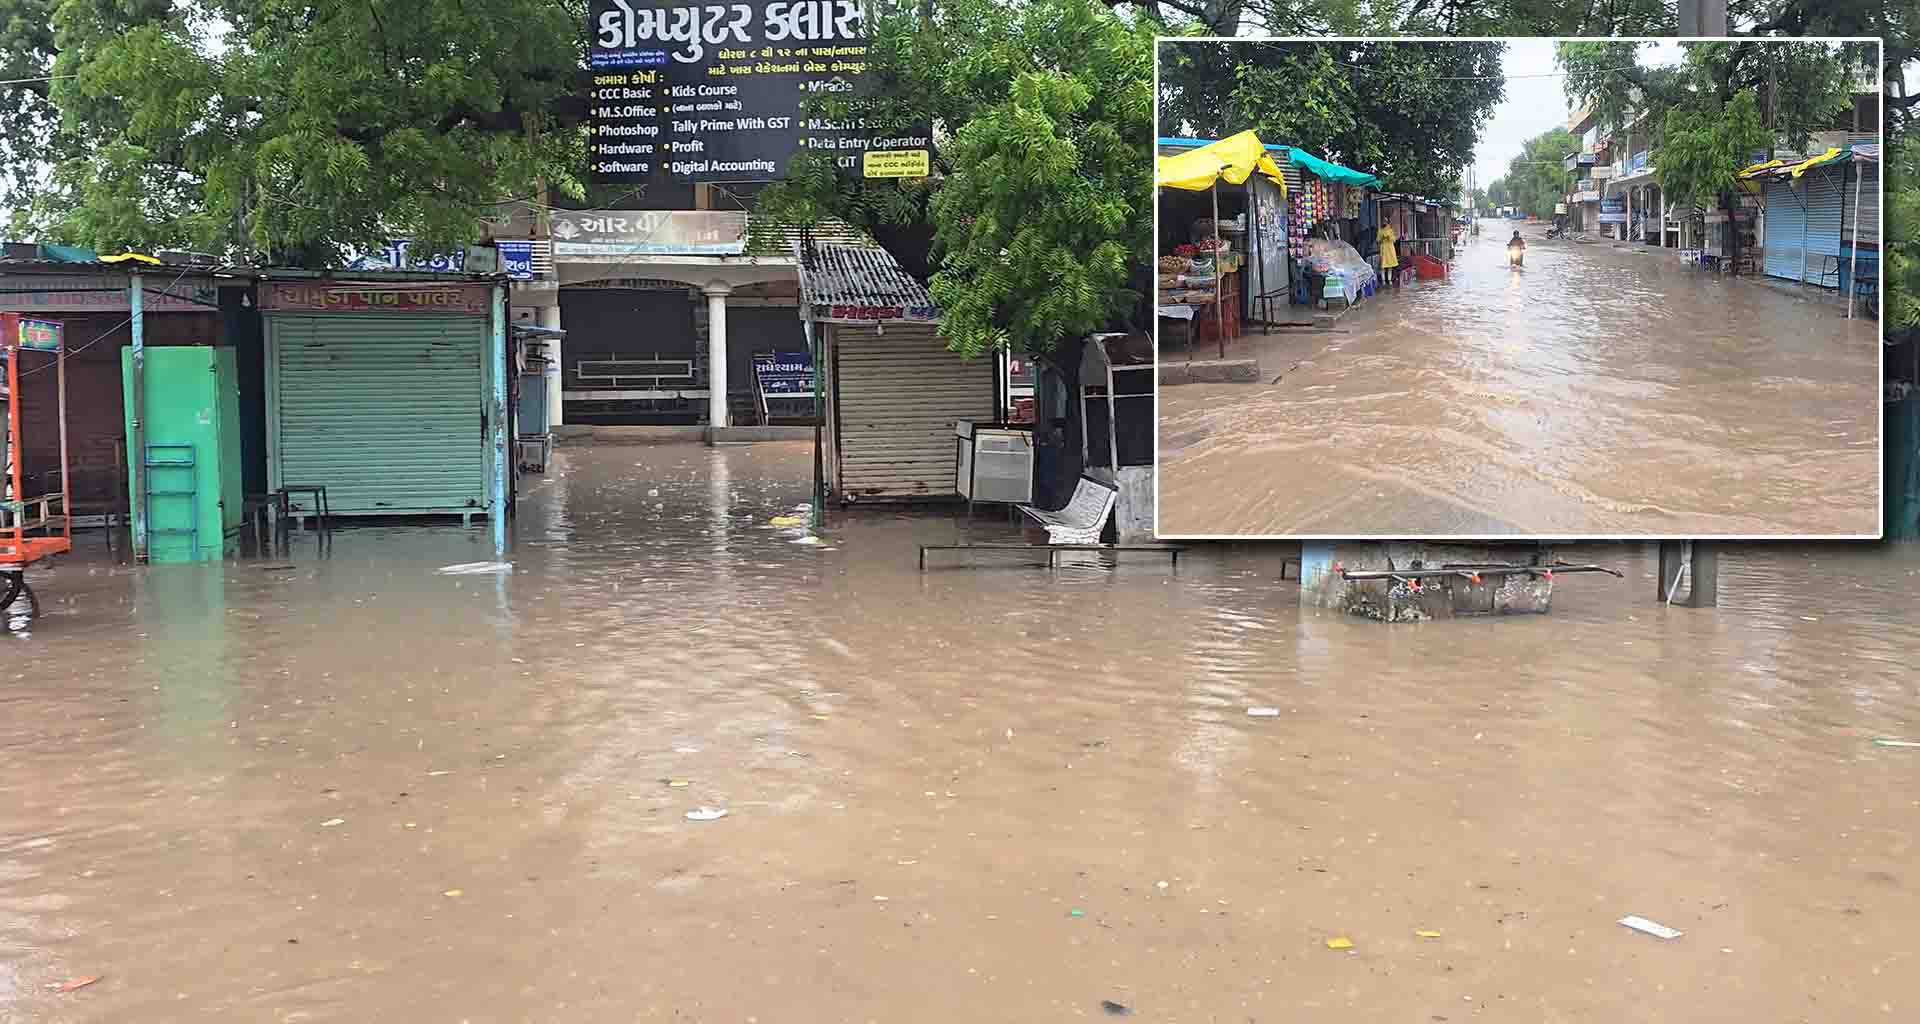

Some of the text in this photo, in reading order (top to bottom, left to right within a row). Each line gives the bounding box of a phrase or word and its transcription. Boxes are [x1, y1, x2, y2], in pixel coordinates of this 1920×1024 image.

[598, 0, 752, 63] કોમ્પ્યુટર
[708, 65, 726, 75] માટે
[594, 74, 627, 85] અમારા
[599, 87, 651, 99] CCC Basic
[672, 85, 737, 97] Kids Course
[599, 105, 656, 118] M.S.Office
[599, 124, 658, 137] Photoshop
[672, 117, 790, 133] Tally Prime With GST
[599, 143, 653, 154] Hardware
[672, 140, 704, 152] Profit
[808, 136, 927, 150] Data Entry Operator
[599, 161, 649, 172] Software
[672, 159, 775, 174] Digital Accounting
